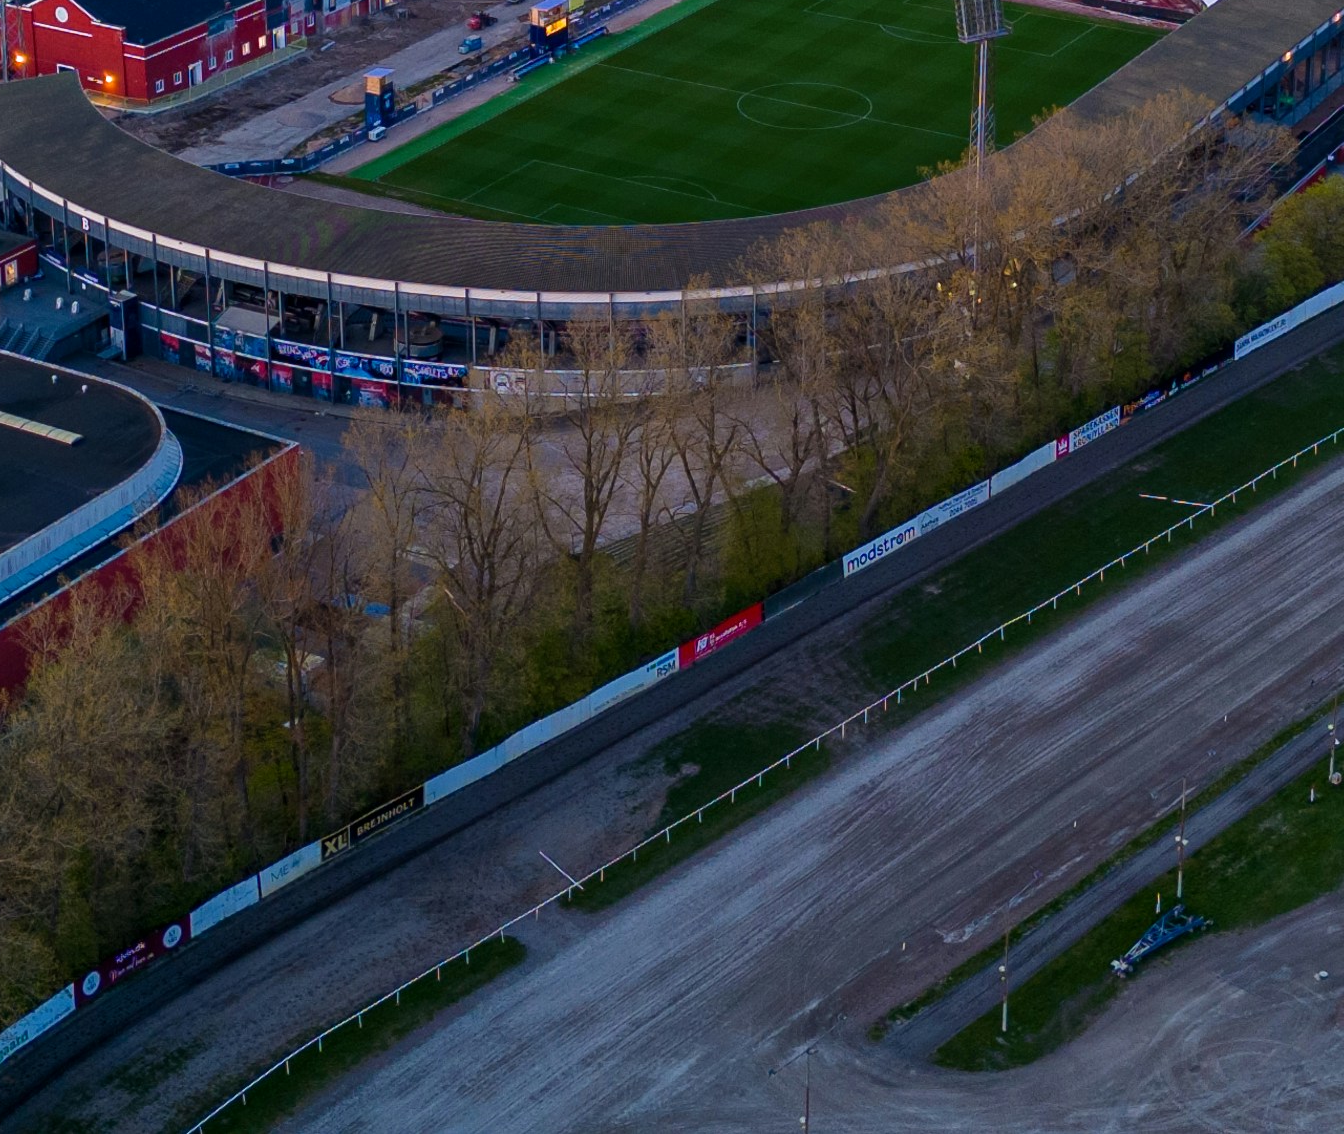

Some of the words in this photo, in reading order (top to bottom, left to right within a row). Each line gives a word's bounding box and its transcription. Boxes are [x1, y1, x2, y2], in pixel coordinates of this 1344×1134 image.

[81, 216, 90, 231] B
[656, 660, 676, 678] RSM
[356, 797, 415, 836] BREJNHOLT
